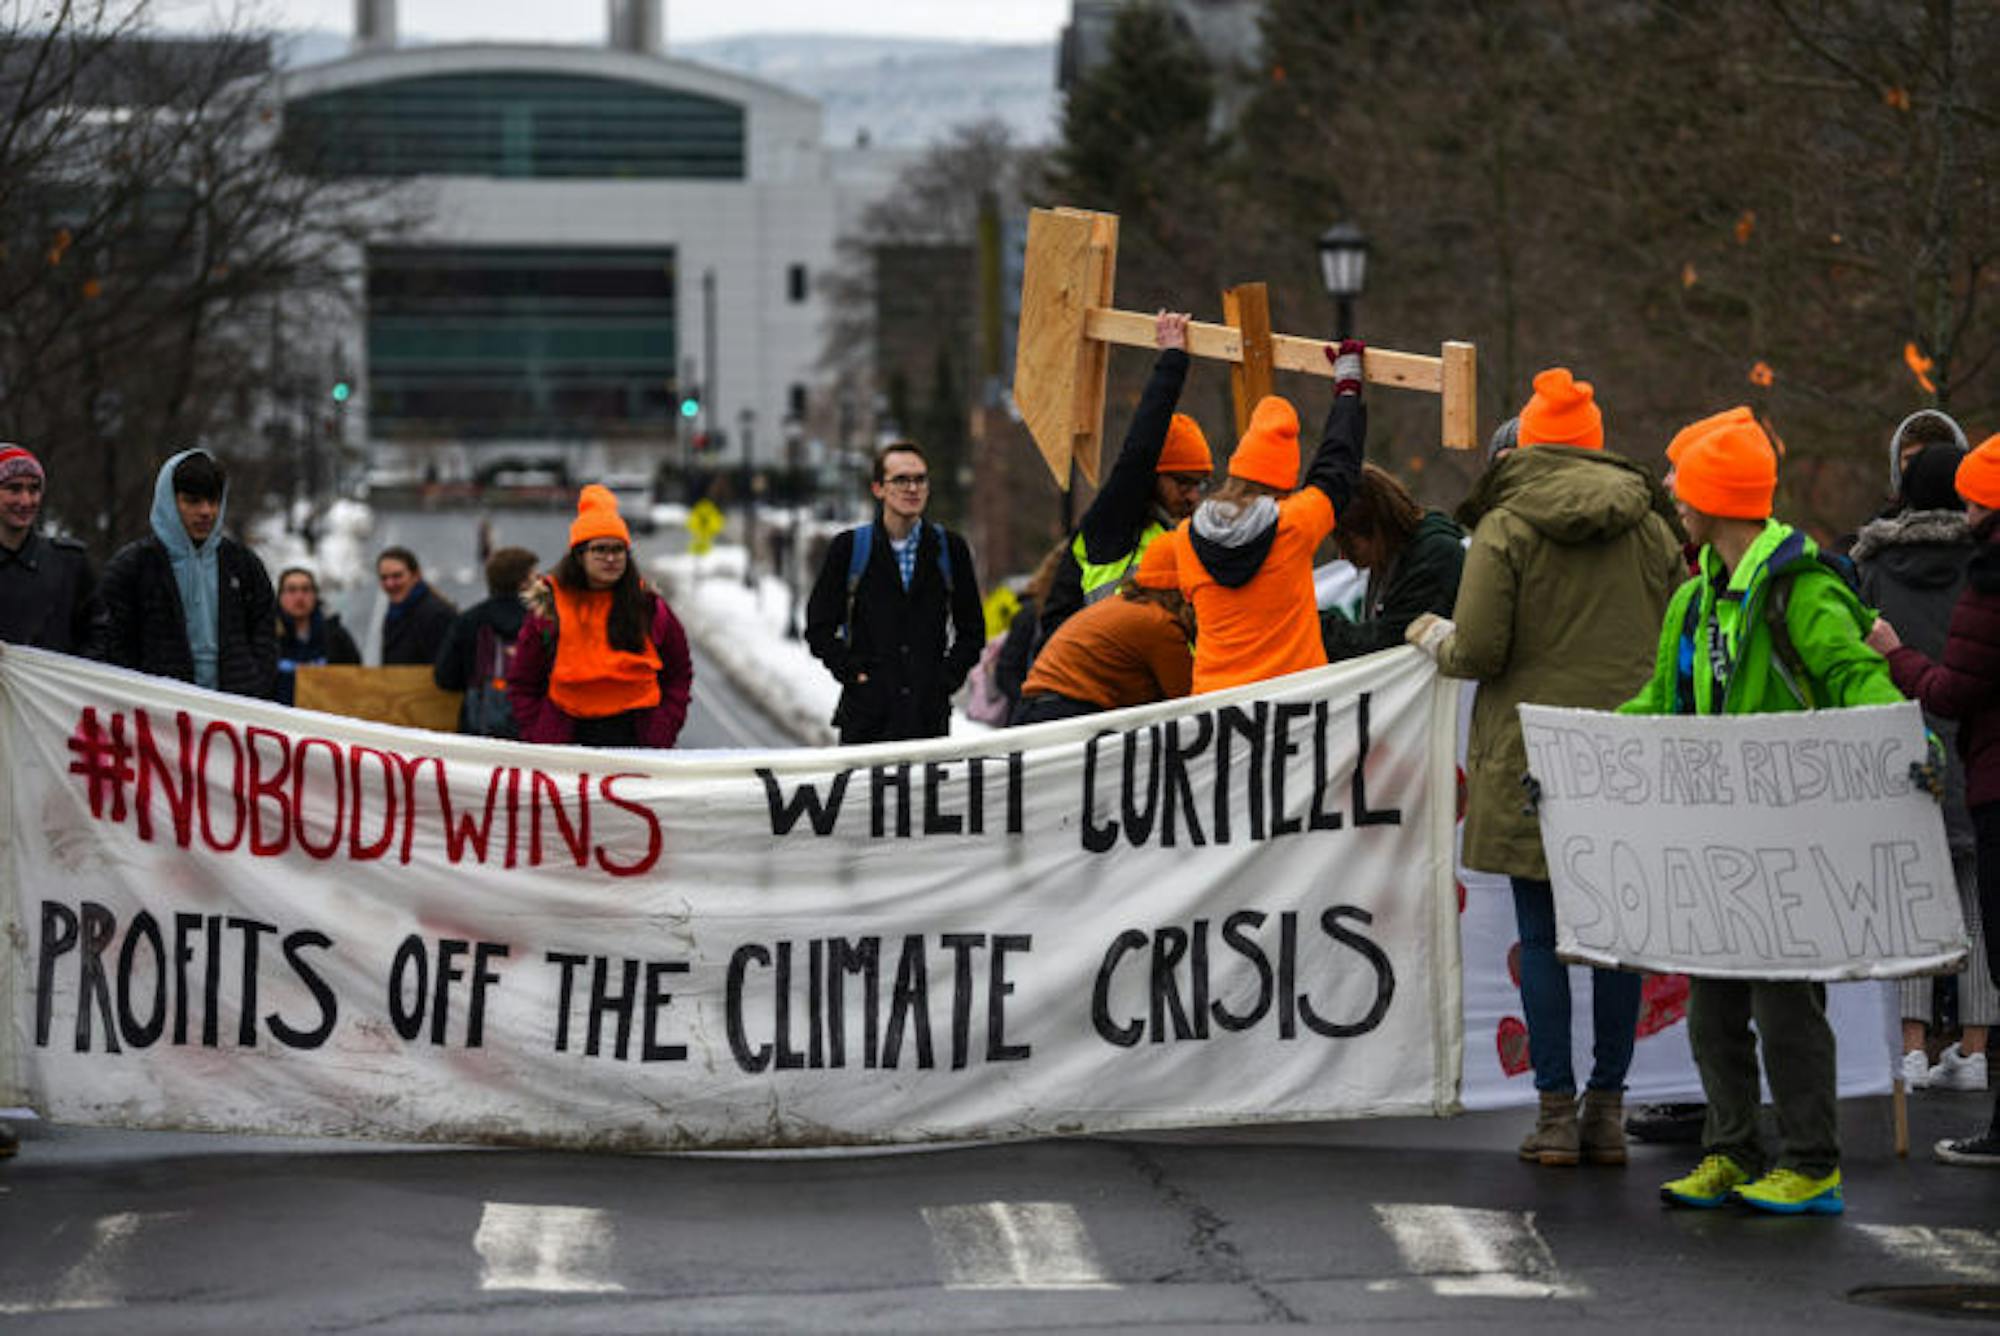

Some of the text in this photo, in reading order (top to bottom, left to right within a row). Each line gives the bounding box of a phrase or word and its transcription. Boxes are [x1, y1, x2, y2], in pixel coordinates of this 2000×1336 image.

[1081, 693, 1401, 853] CORNELL
[1660, 738, 1734, 805] ARE
[1741, 737, 1910, 807] RISING
[1562, 834, 1945, 959] SO ARE WE
[35, 900, 1395, 1074] PROFITS OFF THE CLIMATE CRISIS
